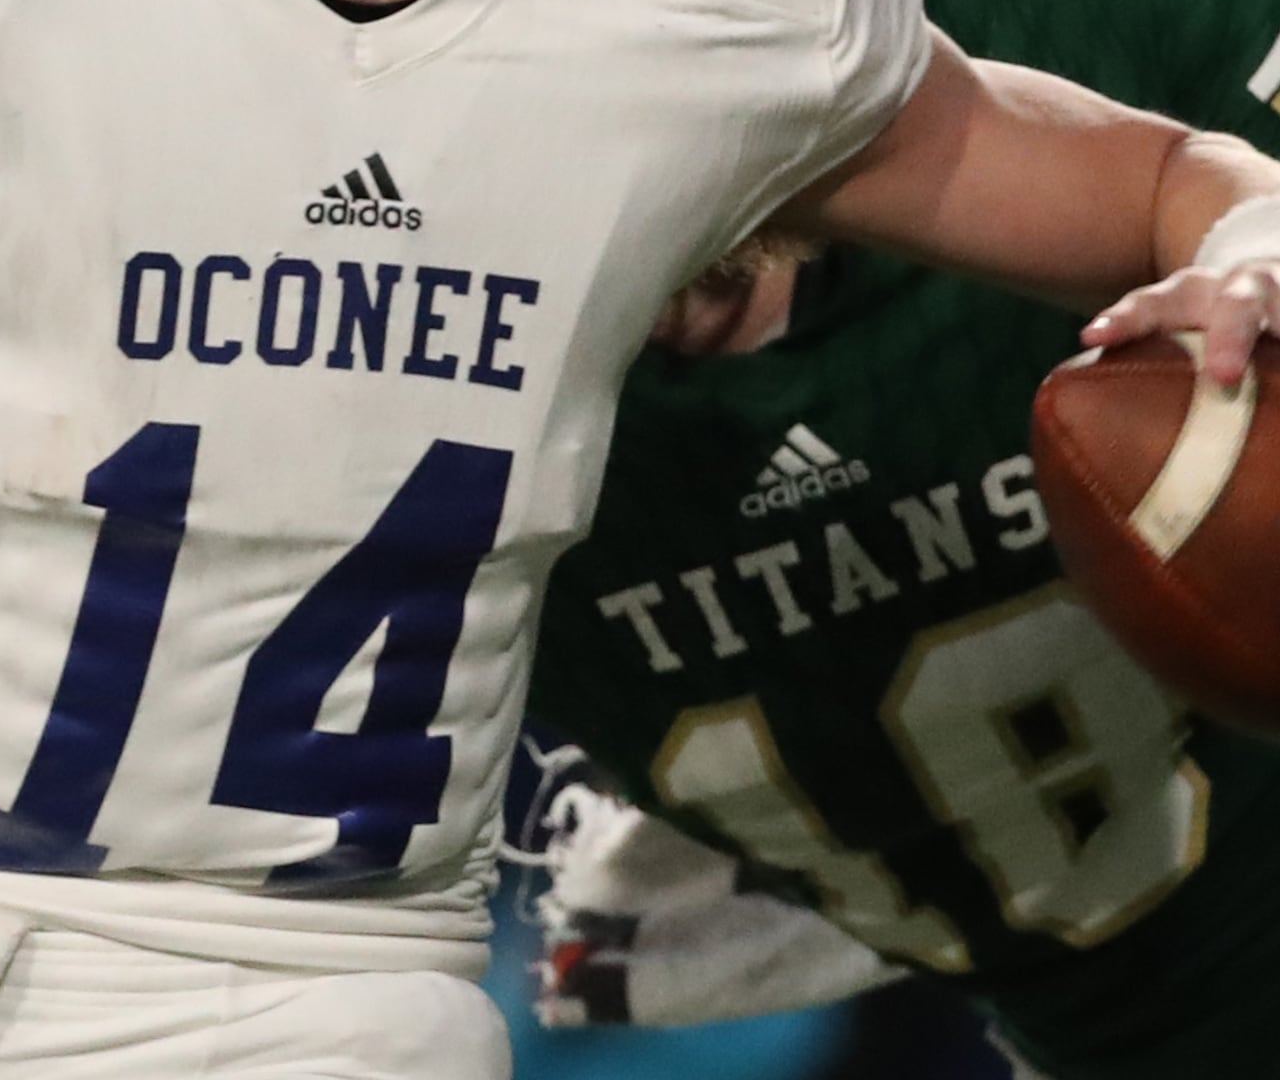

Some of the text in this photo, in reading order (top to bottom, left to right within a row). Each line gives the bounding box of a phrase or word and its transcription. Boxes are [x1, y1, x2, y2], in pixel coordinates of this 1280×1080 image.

[305, 197, 423, 231] adidas
[117, 251, 540, 391] OCONEE
[739, 459, 871, 519] adidas
[597, 453, 1051, 674] TITANS
[650, 580, 1212, 975] 18
